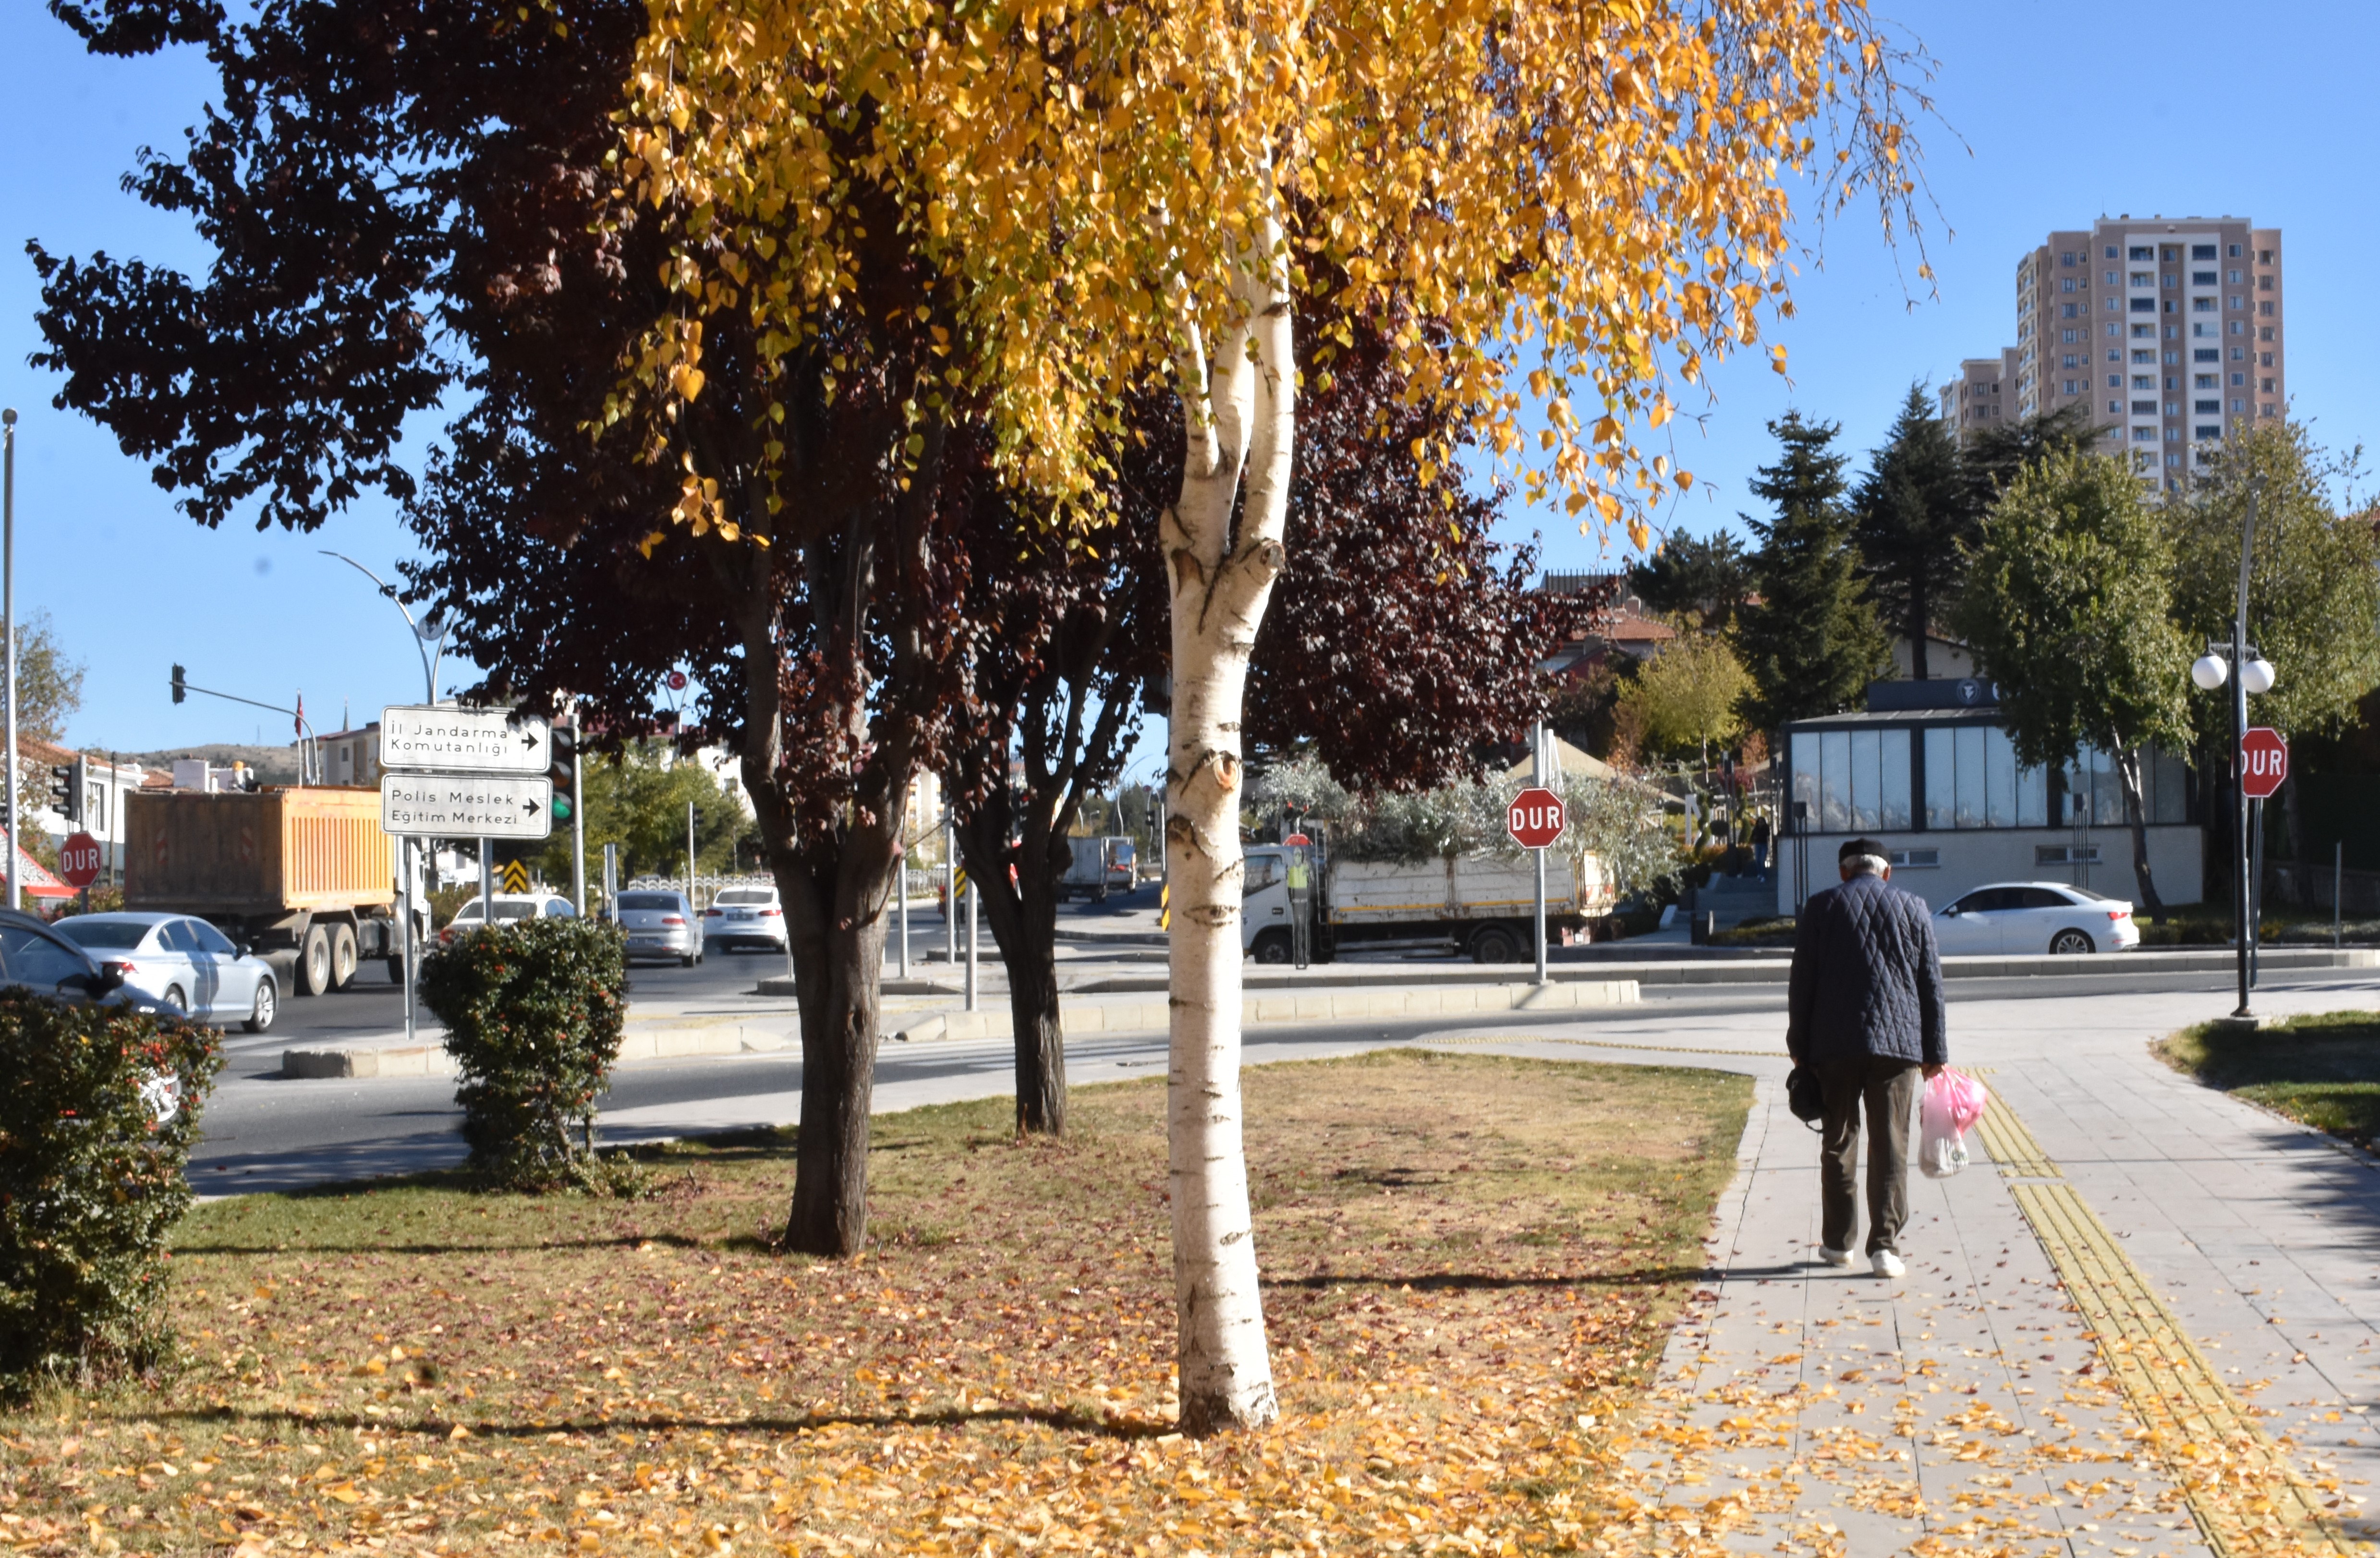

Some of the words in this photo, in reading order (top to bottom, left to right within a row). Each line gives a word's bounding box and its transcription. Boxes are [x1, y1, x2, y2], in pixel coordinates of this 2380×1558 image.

[391, 720, 402, 734] İl
[414, 724, 508, 739] Jandarma
[391, 739, 507, 756] Komutanlığı
[392, 790, 437, 802] Polis
[449, 791, 513, 805] Meslek
[392, 810, 446, 824] Eğitim
[452, 812, 517, 825] Merkezi
[1512, 806, 1560, 831] DUR
[63, 848, 98, 873] DUR
